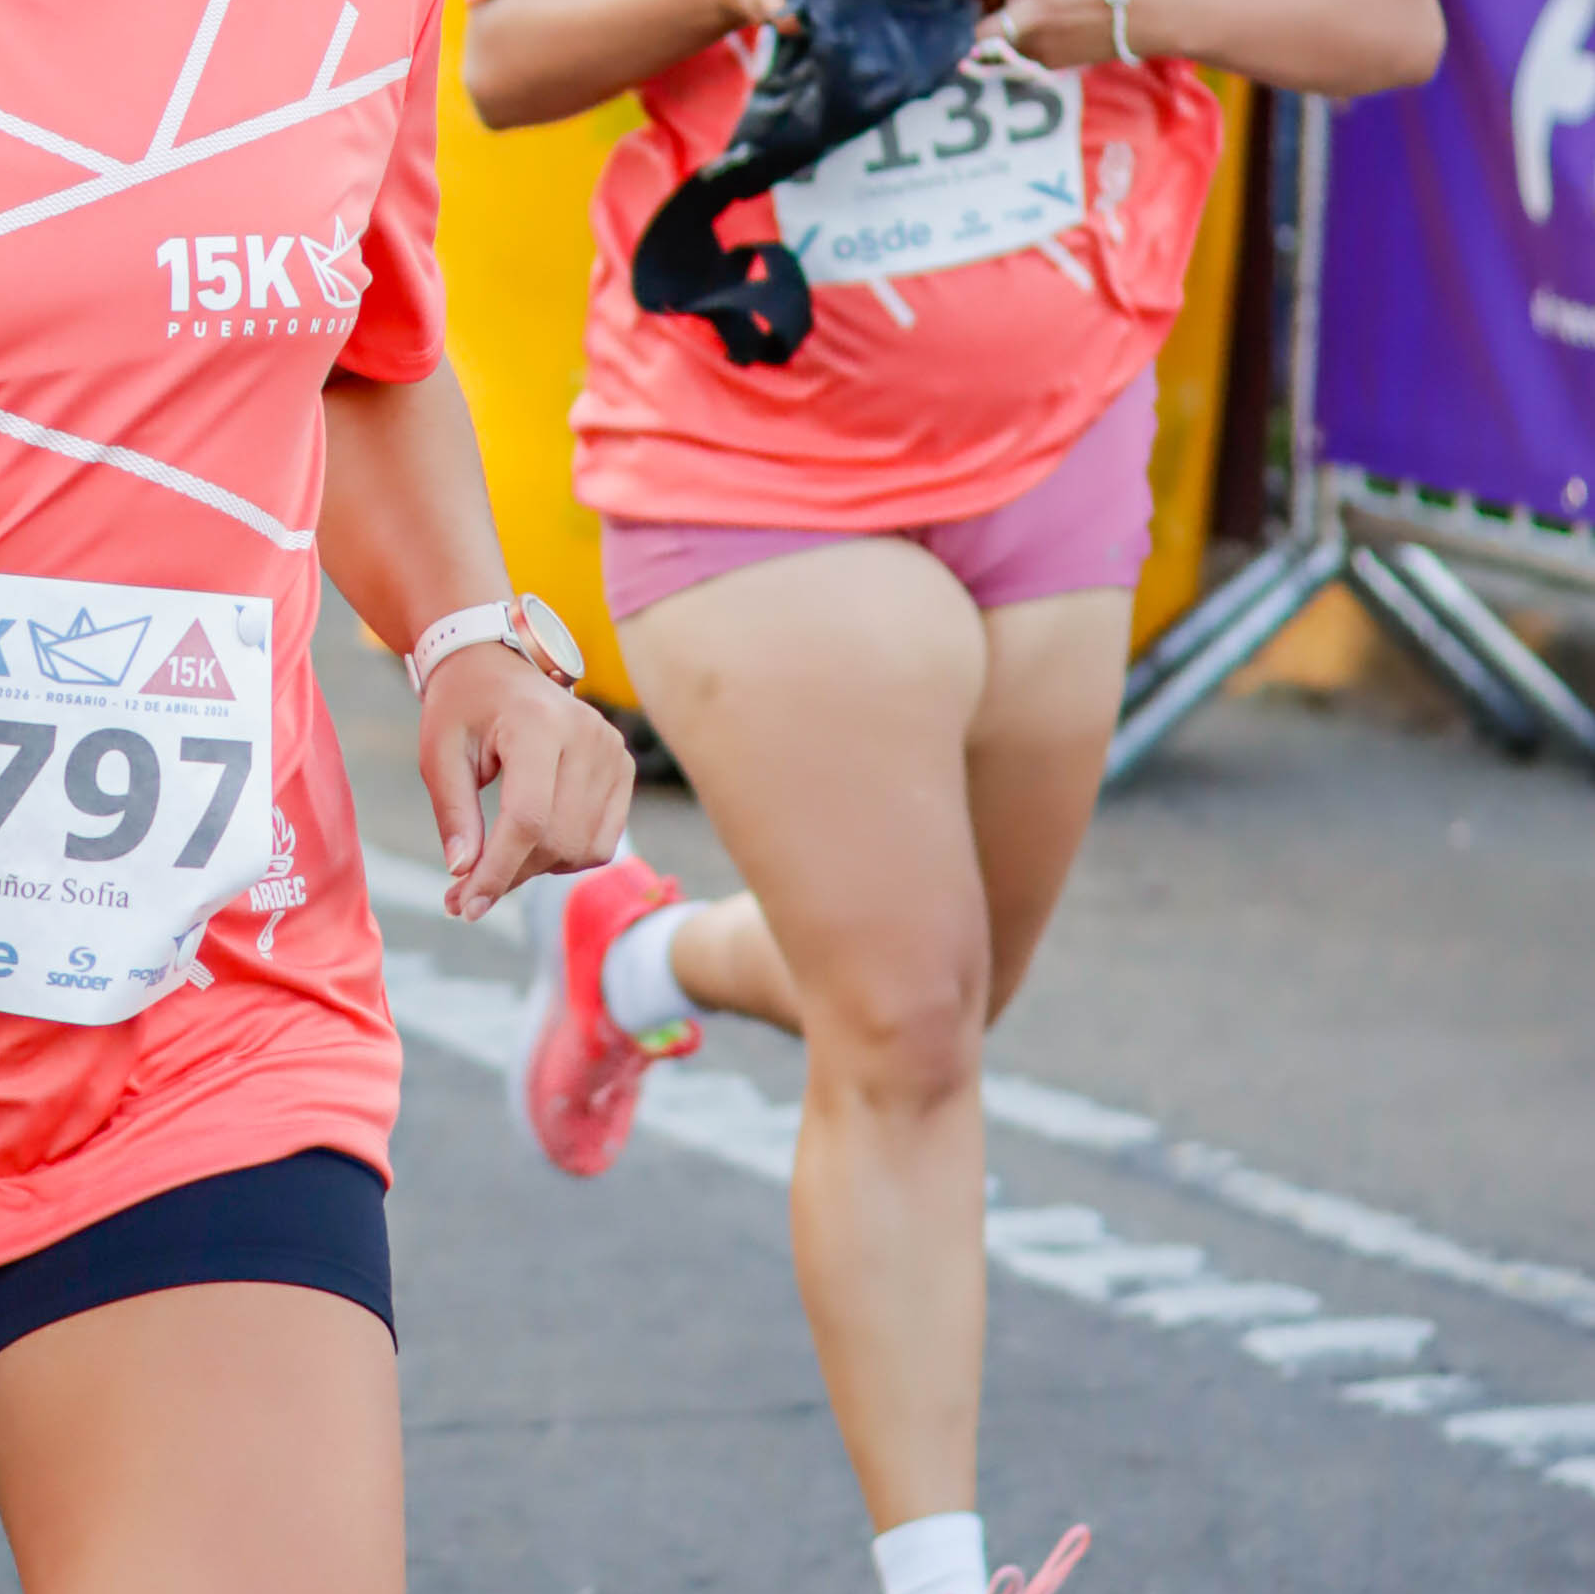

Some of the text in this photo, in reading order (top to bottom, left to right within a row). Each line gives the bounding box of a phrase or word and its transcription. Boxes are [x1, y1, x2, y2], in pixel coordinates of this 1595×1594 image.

[832, 217, 932, 263] osde
[156, 234, 301, 312] 15K
[166, 317, 299, 339] PUERTO
[168, 654, 216, 689] 15K
[46, 691, 107, 707] ROSARIO
[125, 698, 139, 711] 12
[144, 700, 160, 713] DE
[165, 700, 199, 716] ABRIL
